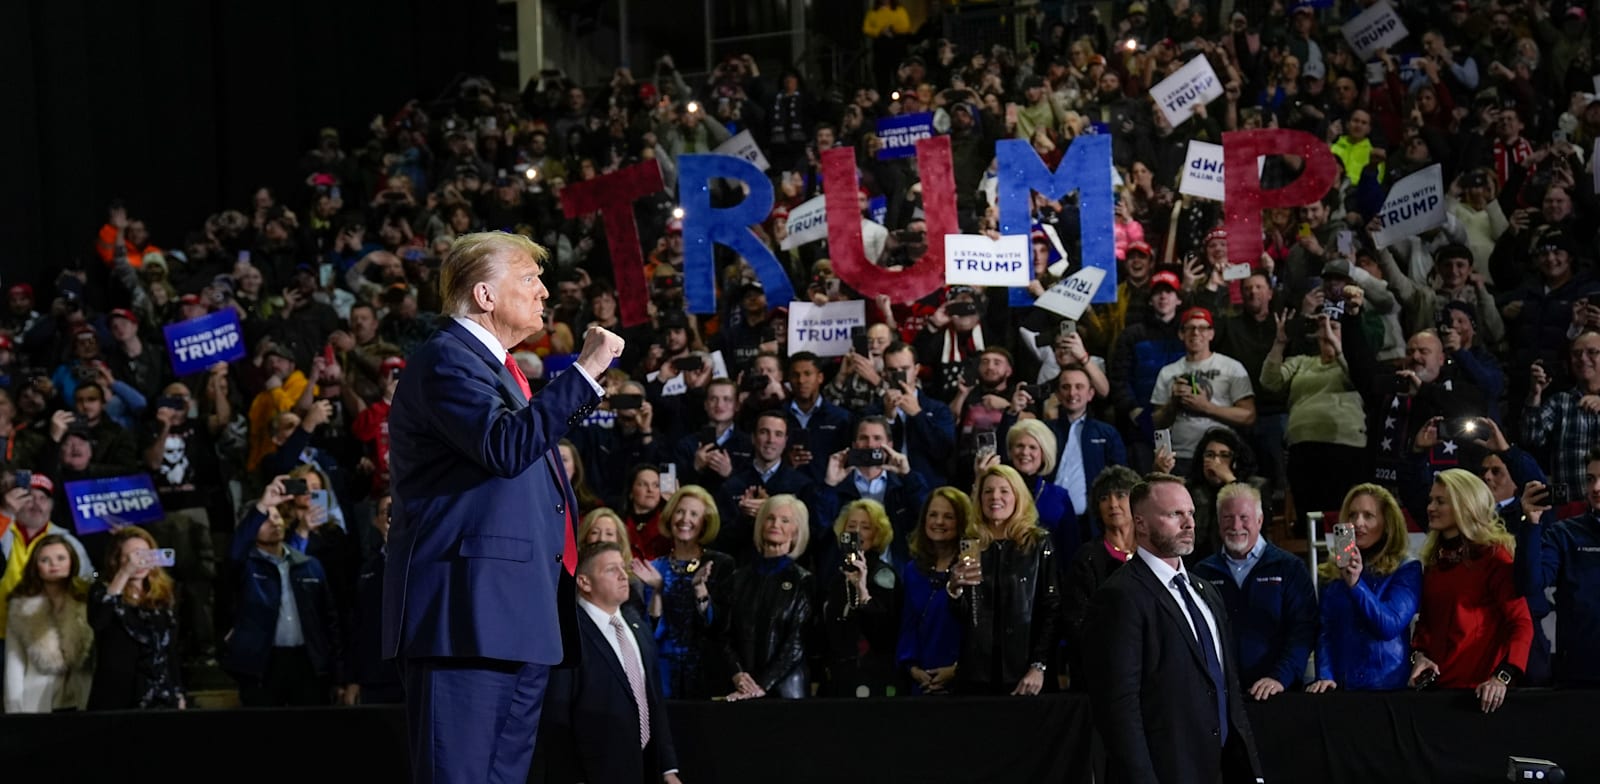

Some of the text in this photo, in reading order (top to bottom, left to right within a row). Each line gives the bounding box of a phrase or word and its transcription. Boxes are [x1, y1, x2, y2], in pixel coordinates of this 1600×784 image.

[1354, 19, 1396, 51] TRUMP
[1166, 77, 1213, 112] TRUMP
[1412, 184, 1436, 198] WITH
[1380, 195, 1438, 228] TRUMP
[954, 259, 1022, 272] TRUMP
[179, 330, 212, 347] STAND
[213, 323, 236, 336] WITH
[175, 332, 240, 362] TRUMP
[1375, 467, 1397, 480] 2024
[77, 496, 155, 519] TRUMP
[83, 492, 117, 503] STAND
